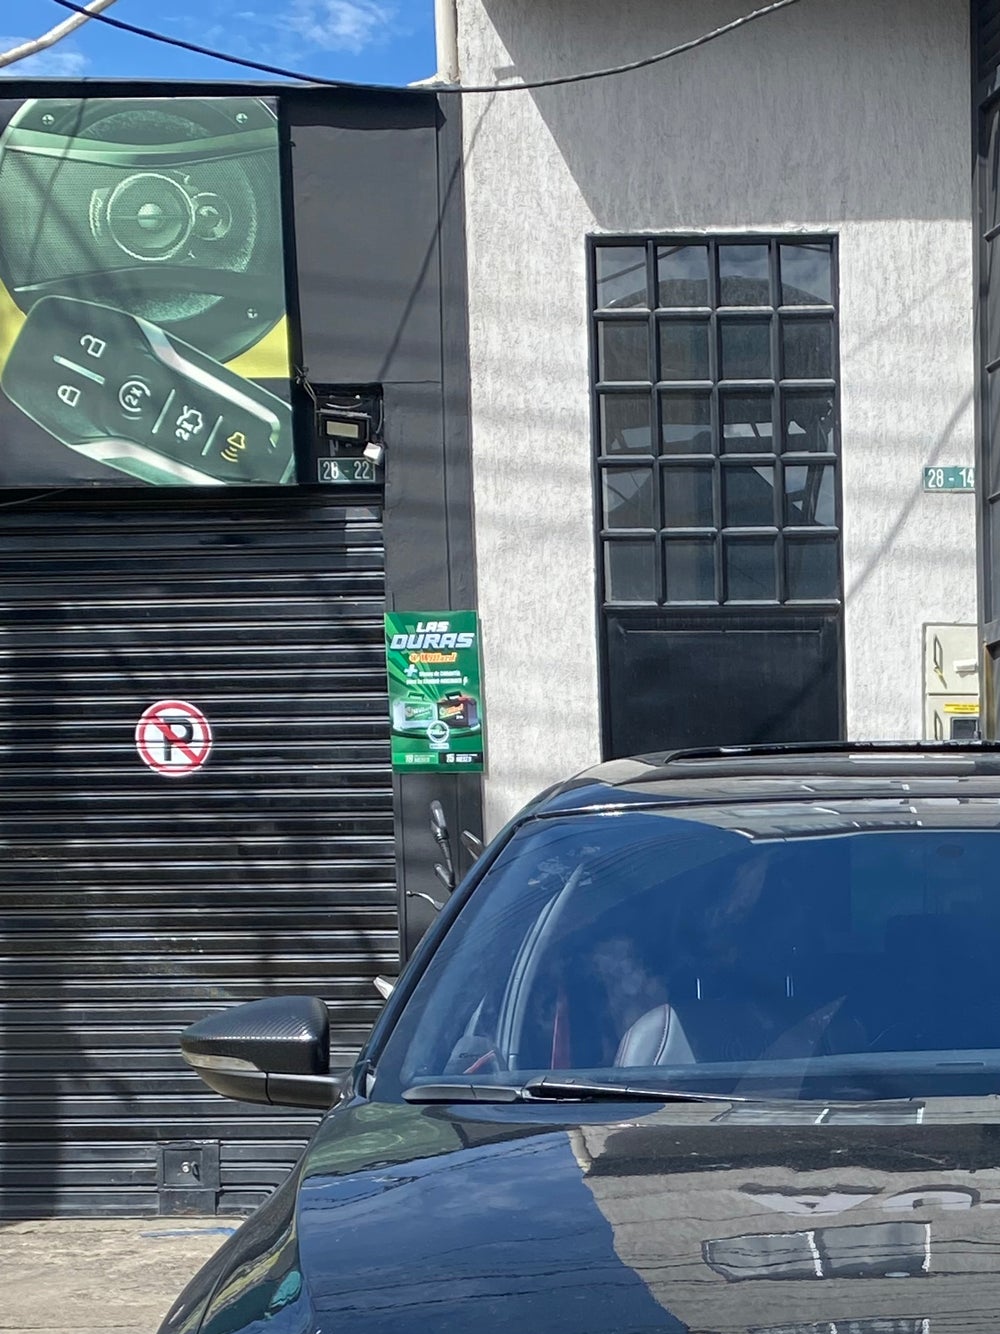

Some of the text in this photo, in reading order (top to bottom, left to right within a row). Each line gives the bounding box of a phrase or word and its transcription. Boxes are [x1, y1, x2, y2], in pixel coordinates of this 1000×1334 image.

[353, 461, 370, 480] 22
[928, 468, 944, 488] 28
[958, 468, 975, 488] 14
[416, 621, 449, 633] LAS
[390, 632, 475, 650] DURAS
